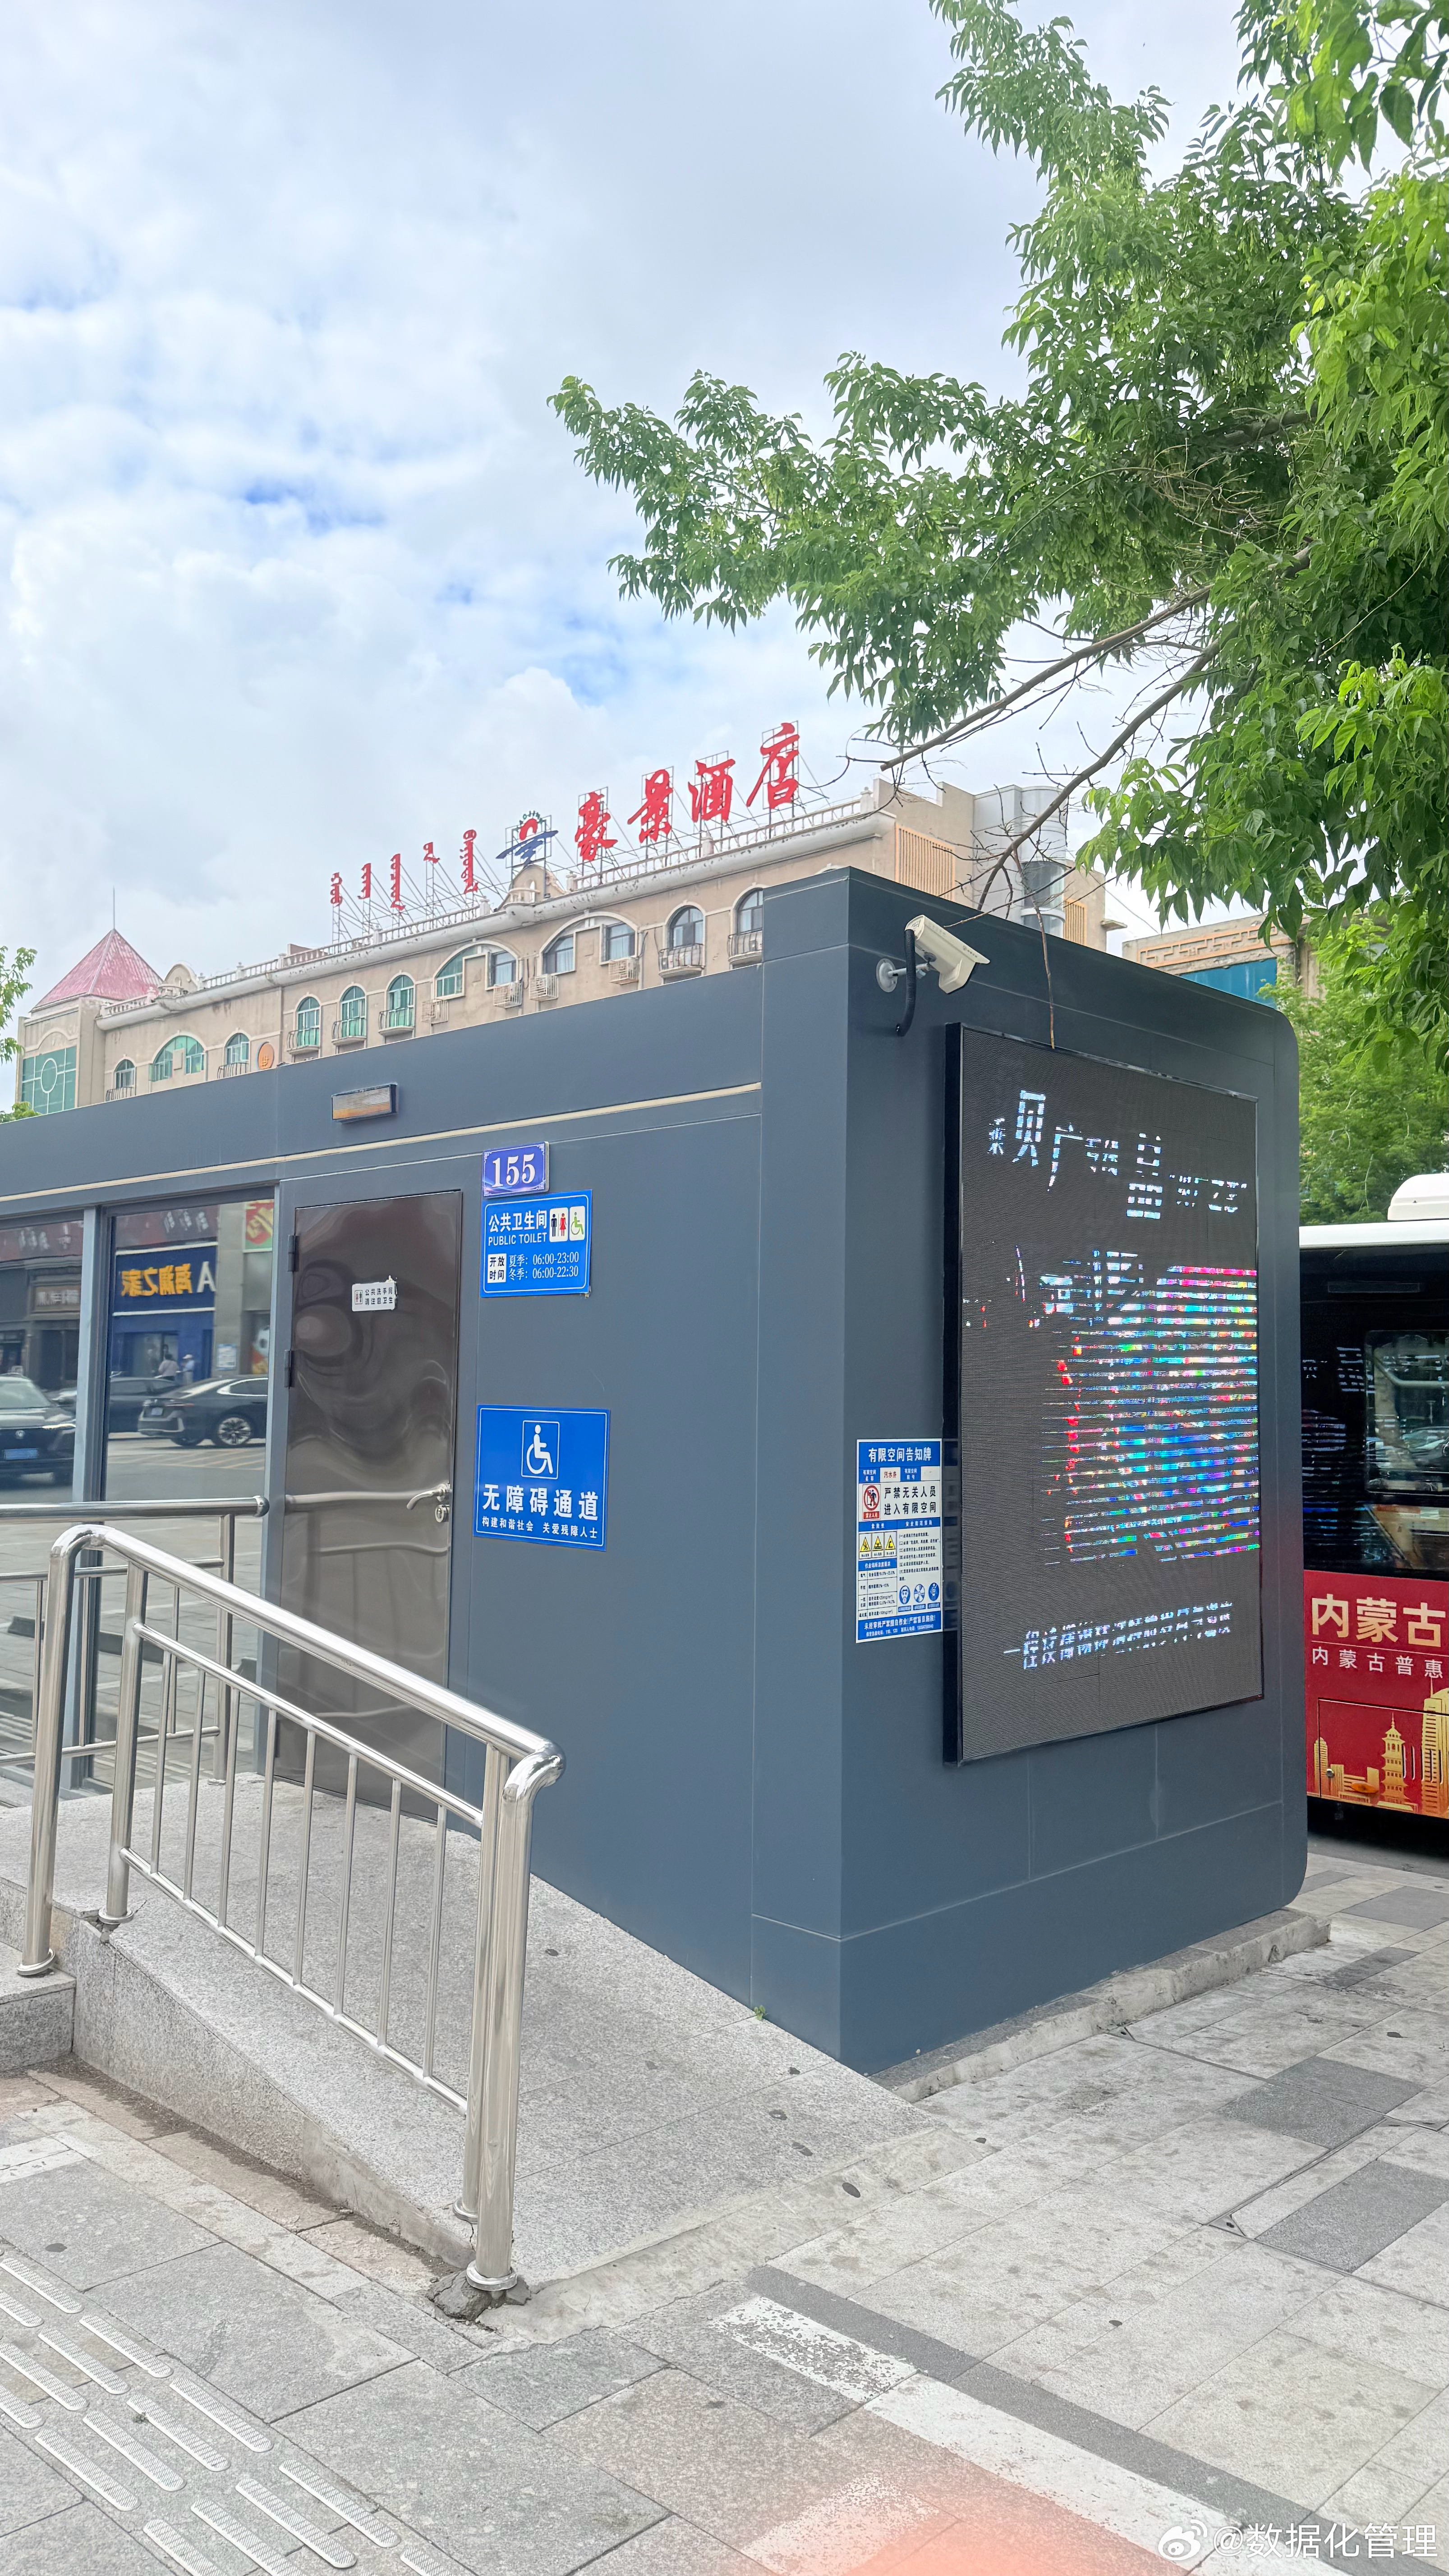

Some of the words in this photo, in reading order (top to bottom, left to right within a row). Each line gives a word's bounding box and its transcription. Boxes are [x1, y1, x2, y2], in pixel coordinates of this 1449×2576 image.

[575, 722, 800, 862] 豪景酒店
[492, 1153, 535, 1188] 155
[488, 1209, 547, 1233] 公共卫生间
[488, 1235, 516, 1246] PUBLIC
[519, 1232, 547, 1244] TOILET
[489, 1256, 505, 1267] 开放
[489, 1270, 505, 1280] 时间
[868, 1446, 932, 1463] 有限空间告知牌
[483, 1484, 598, 1521] 无障碍通道
[884, 1486, 936, 1499] 严禁无关人员
[884, 1502, 936, 1515] 进入有限空间
[482, 1516, 534, 1532] 构建和谐社会
[543, 1522, 598, 1539] 关爱残障人士
[1311, 1593, 1446, 1647] 内蒙古
[1312, 1646, 1443, 1679] 内蒙古普惠
